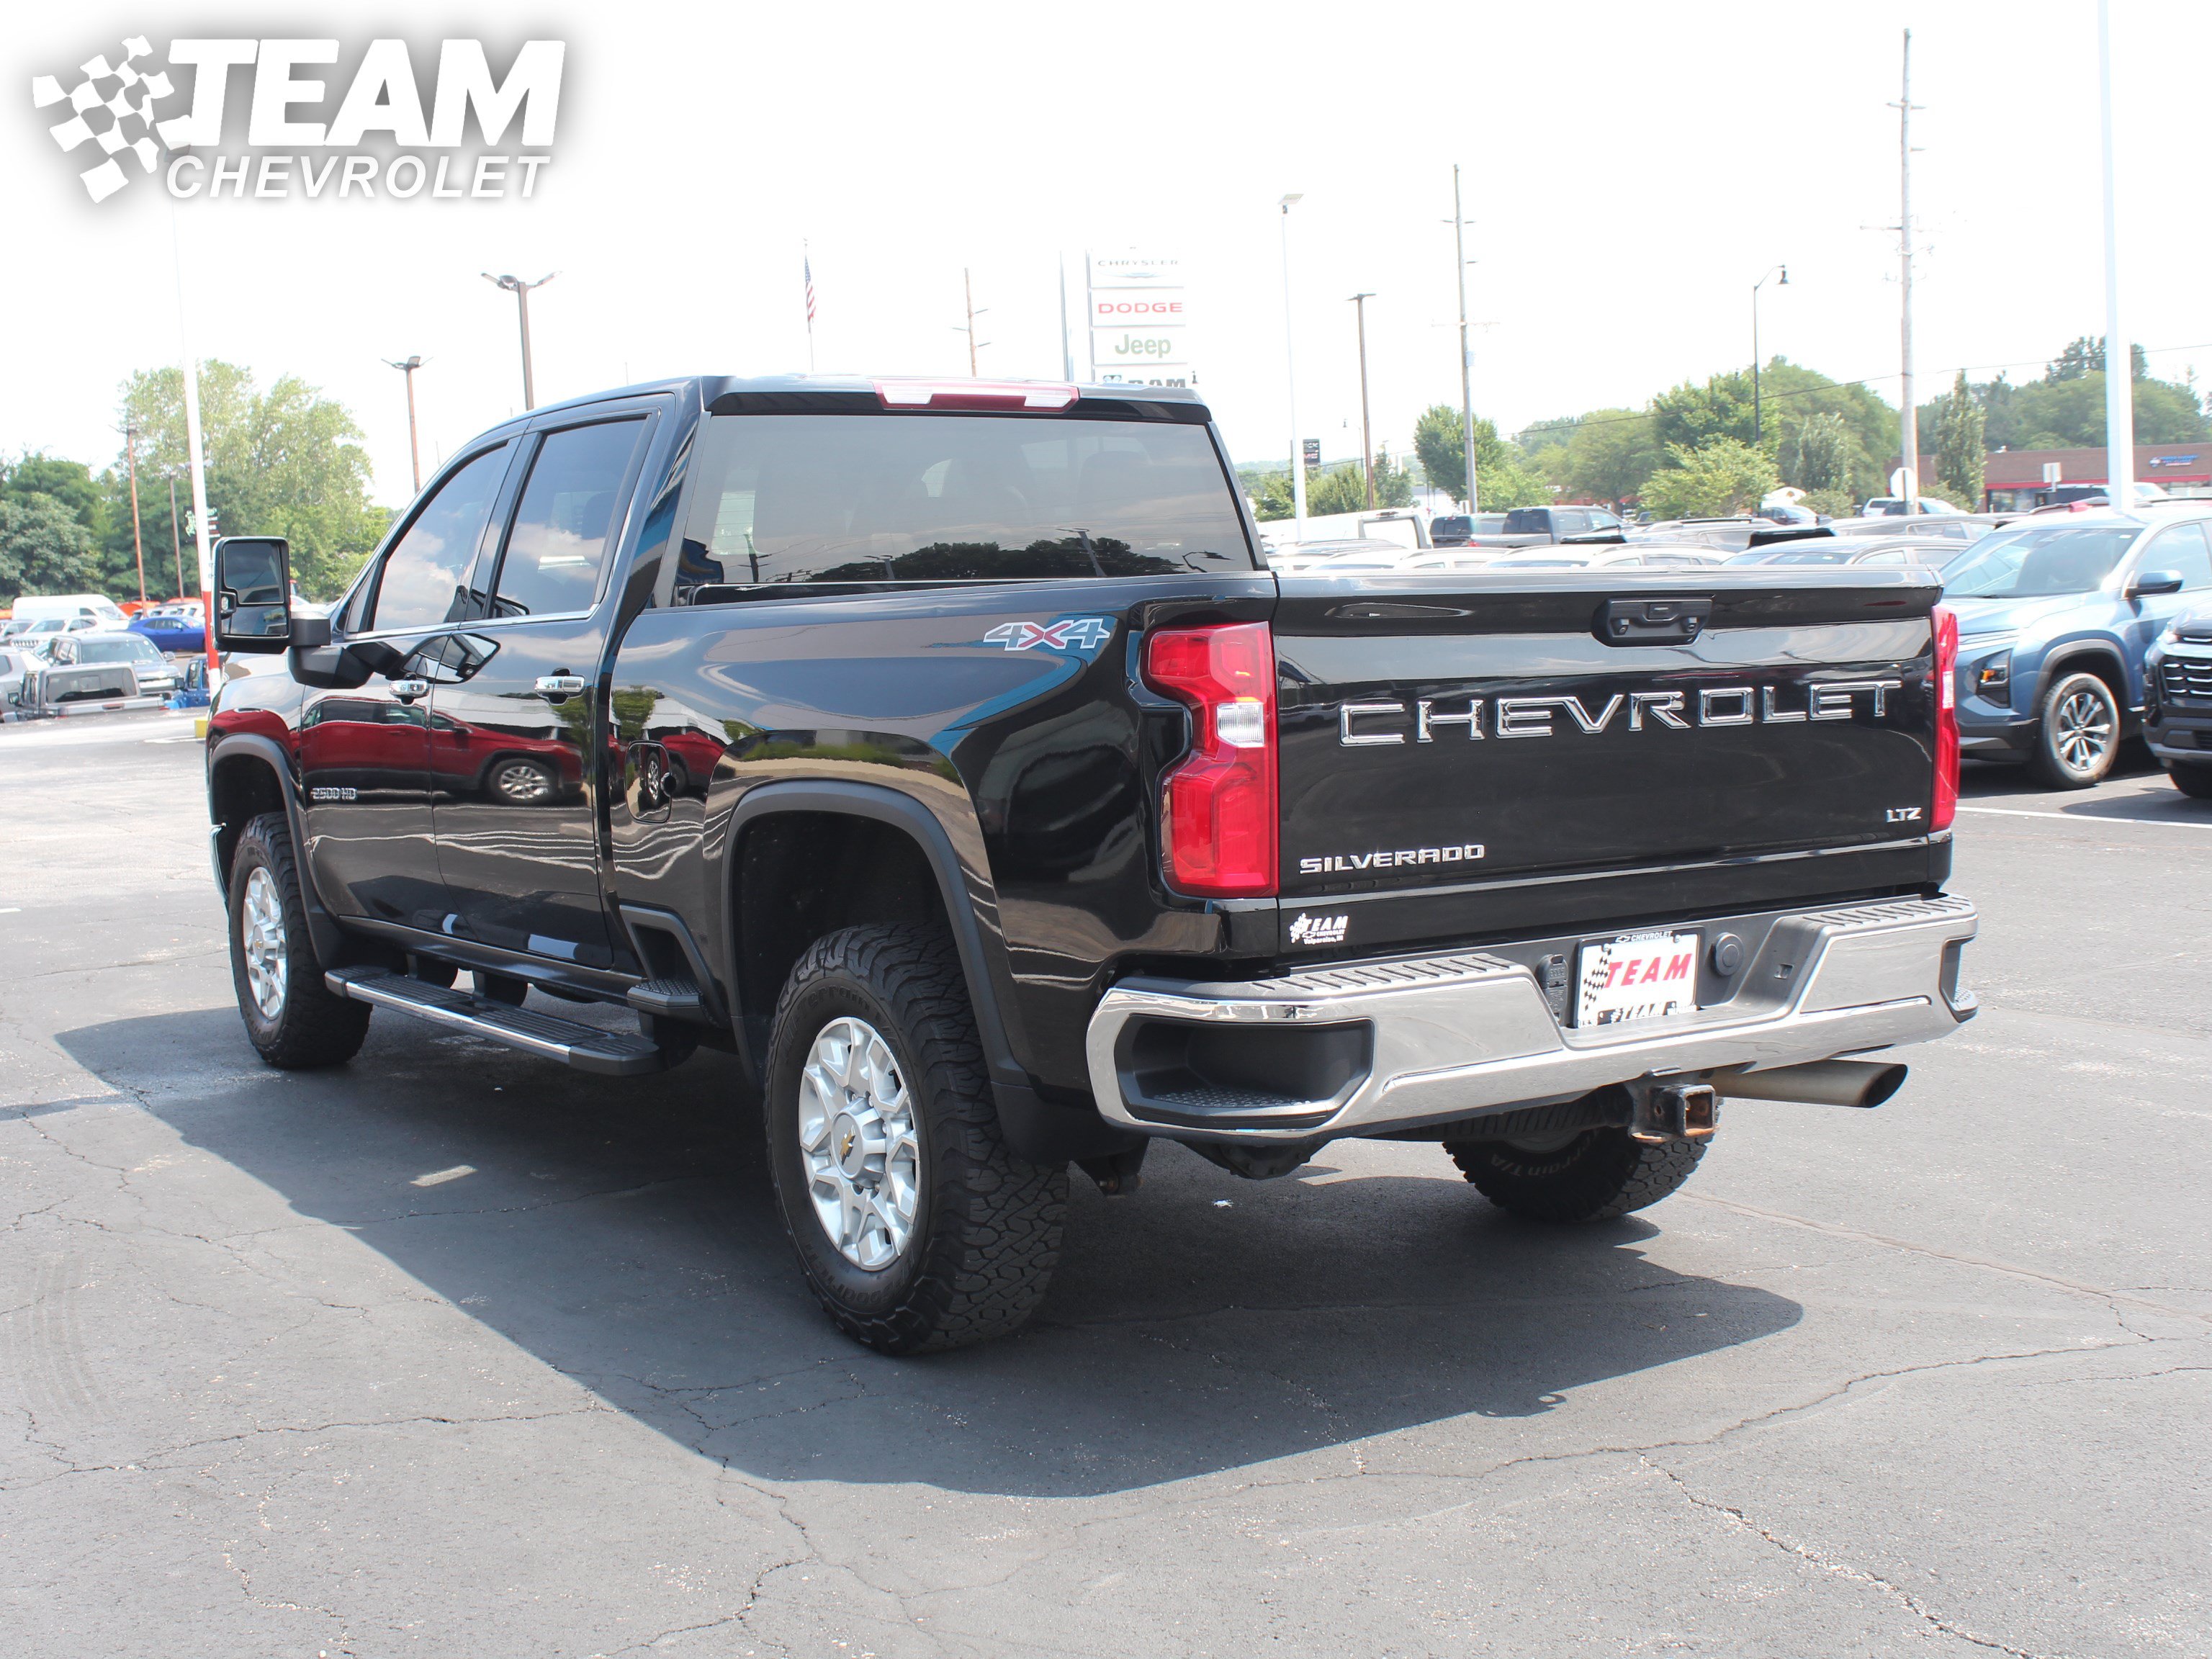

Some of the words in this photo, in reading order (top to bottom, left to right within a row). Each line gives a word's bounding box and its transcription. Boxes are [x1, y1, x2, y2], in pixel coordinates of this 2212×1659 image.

[1098, 302, 1183, 314] DODGE
[1115, 334, 1172, 359] Jeep
[1339, 679, 1903, 748] CHEVROLET
[310, 787, 340, 800] 2500
[341, 787, 356, 800] HD
[1886, 807, 1922, 823] LTZ
[1300, 844, 1485, 874] SILVERADO
[1303, 915, 1349, 932] TEAM
[1630, 930, 1673, 941] CHEVROLET
[1604, 953, 1693, 989] TEAM
